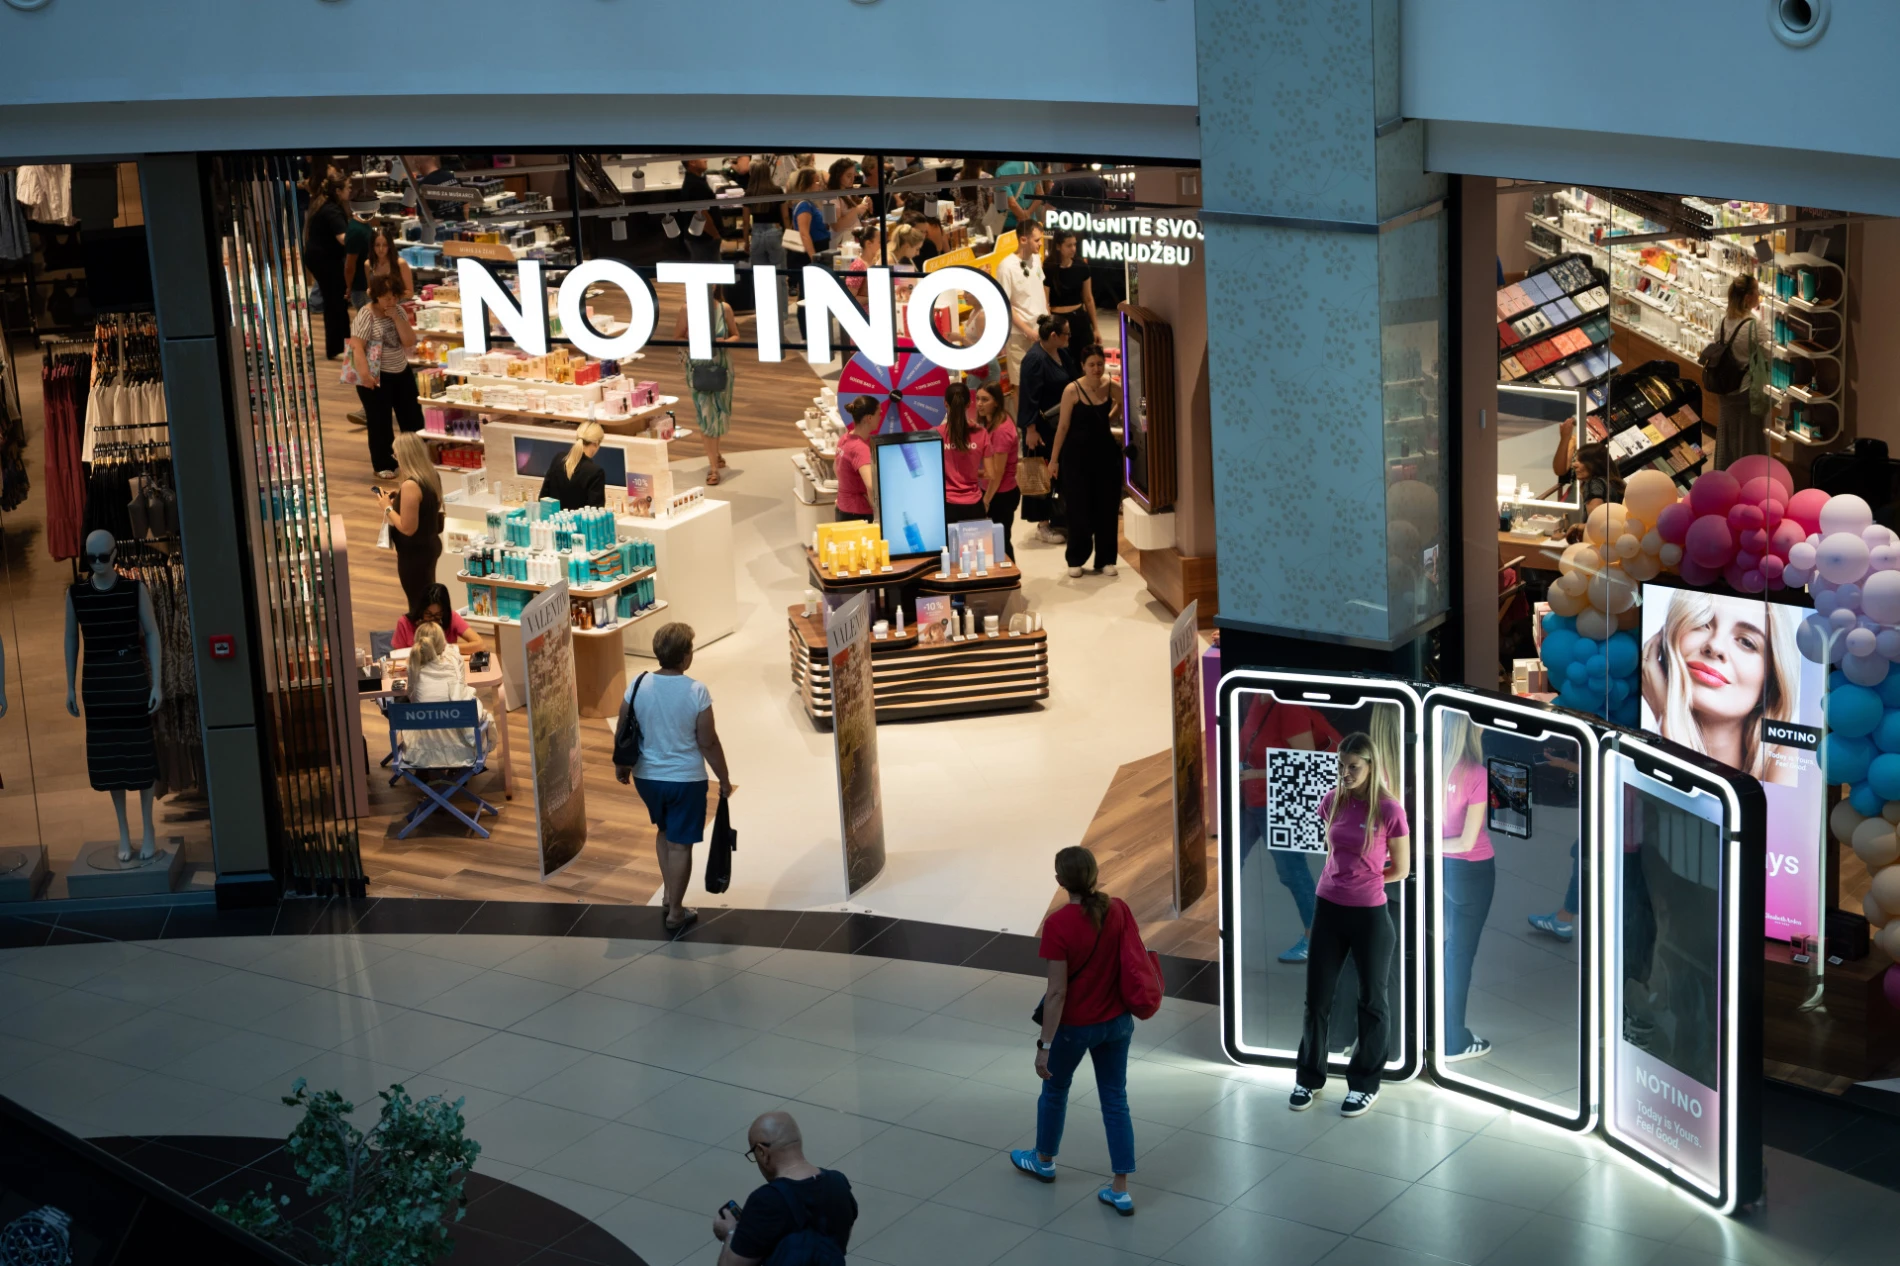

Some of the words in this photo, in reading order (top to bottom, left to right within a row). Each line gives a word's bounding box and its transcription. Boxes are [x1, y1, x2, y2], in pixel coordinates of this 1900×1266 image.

[1045, 210, 1152, 237] PODIGNITE
[1081, 238, 1191, 266] NARUDŽBU
[458, 258, 1009, 370] NOTINO
[405, 709, 460, 721] NOTINO
[1767, 726, 1817, 744] NOTINO
[1636, 1065, 1702, 1119] NOTINO
[1636, 1098, 1662, 1127] Today
[1664, 1115, 1672, 1131] is
[1673, 1120, 1702, 1148] Yours.
[1636, 1115, 1655, 1135] Feel
[1655, 1126, 1680, 1151] Good.
